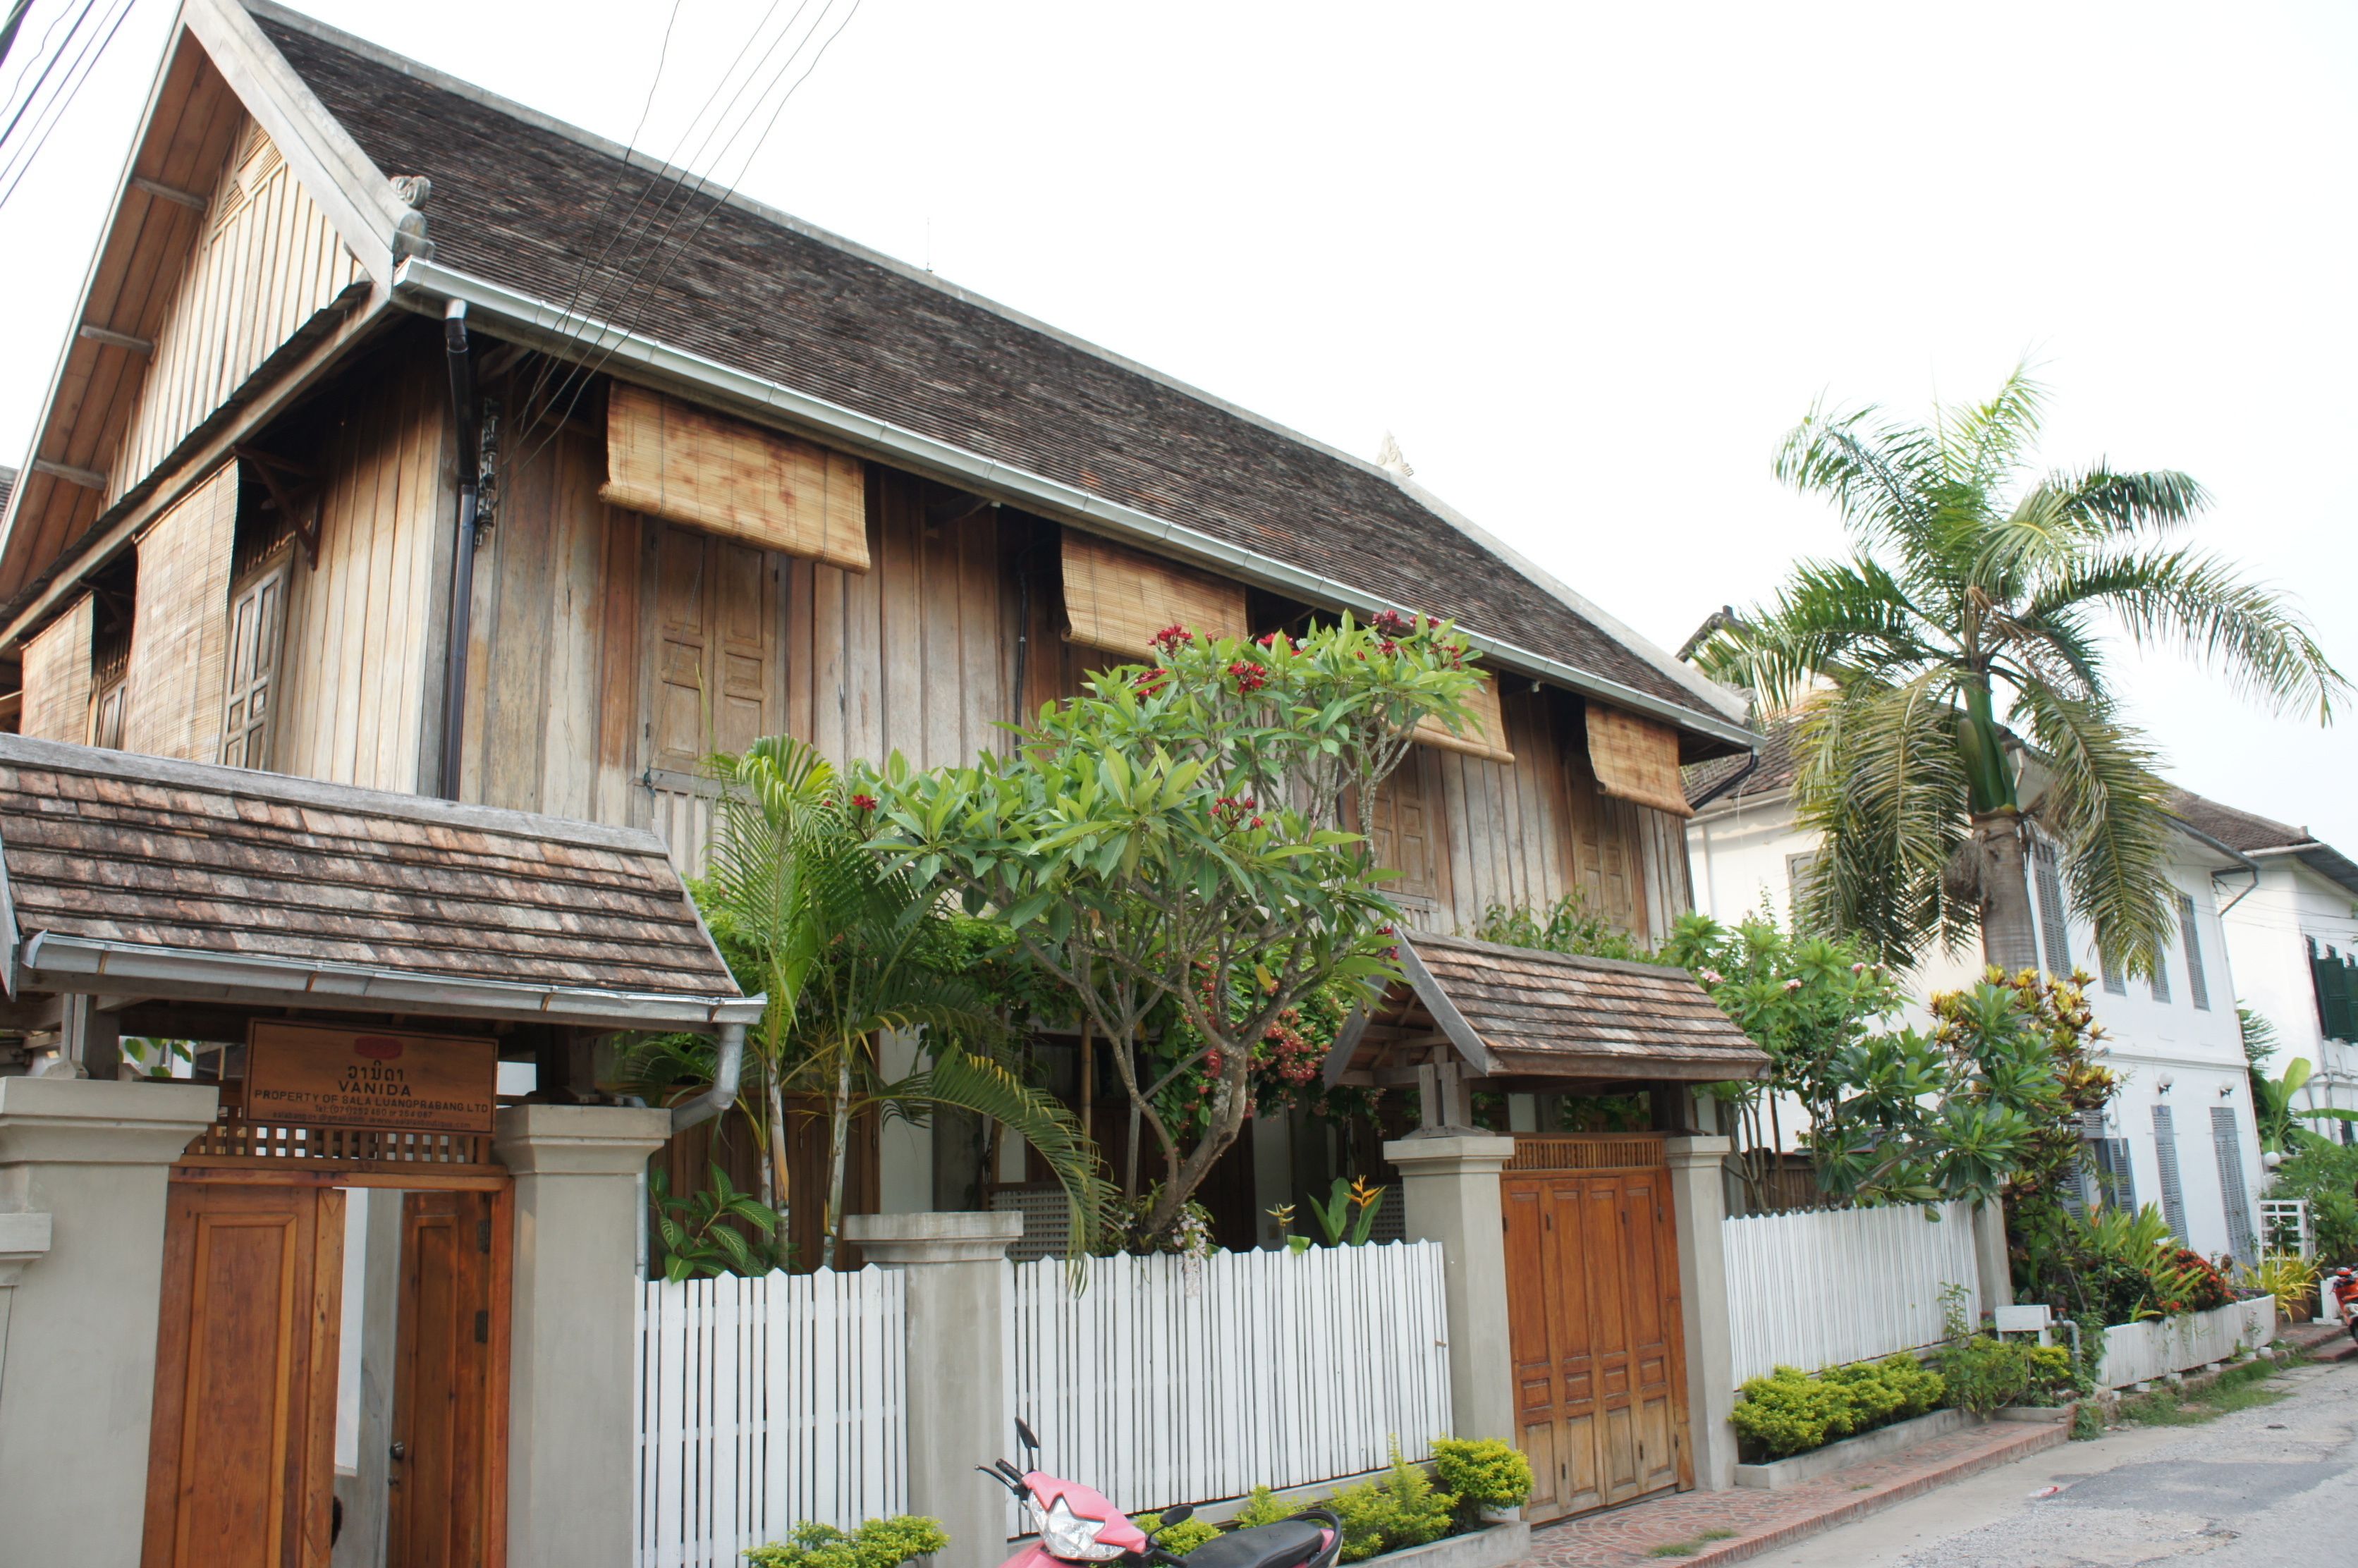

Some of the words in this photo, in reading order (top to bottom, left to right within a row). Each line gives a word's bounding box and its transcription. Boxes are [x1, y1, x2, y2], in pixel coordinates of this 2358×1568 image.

[338, 1079, 411, 1097] VANIDA
[255, 1089, 319, 1102] PROPERTY
[322, 1094, 338, 1103] OF
[342, 1096, 371, 1106] SALA
[375, 1098, 464, 1112] LUANGPRABANG
[467, 1103, 489, 1113] LTD
